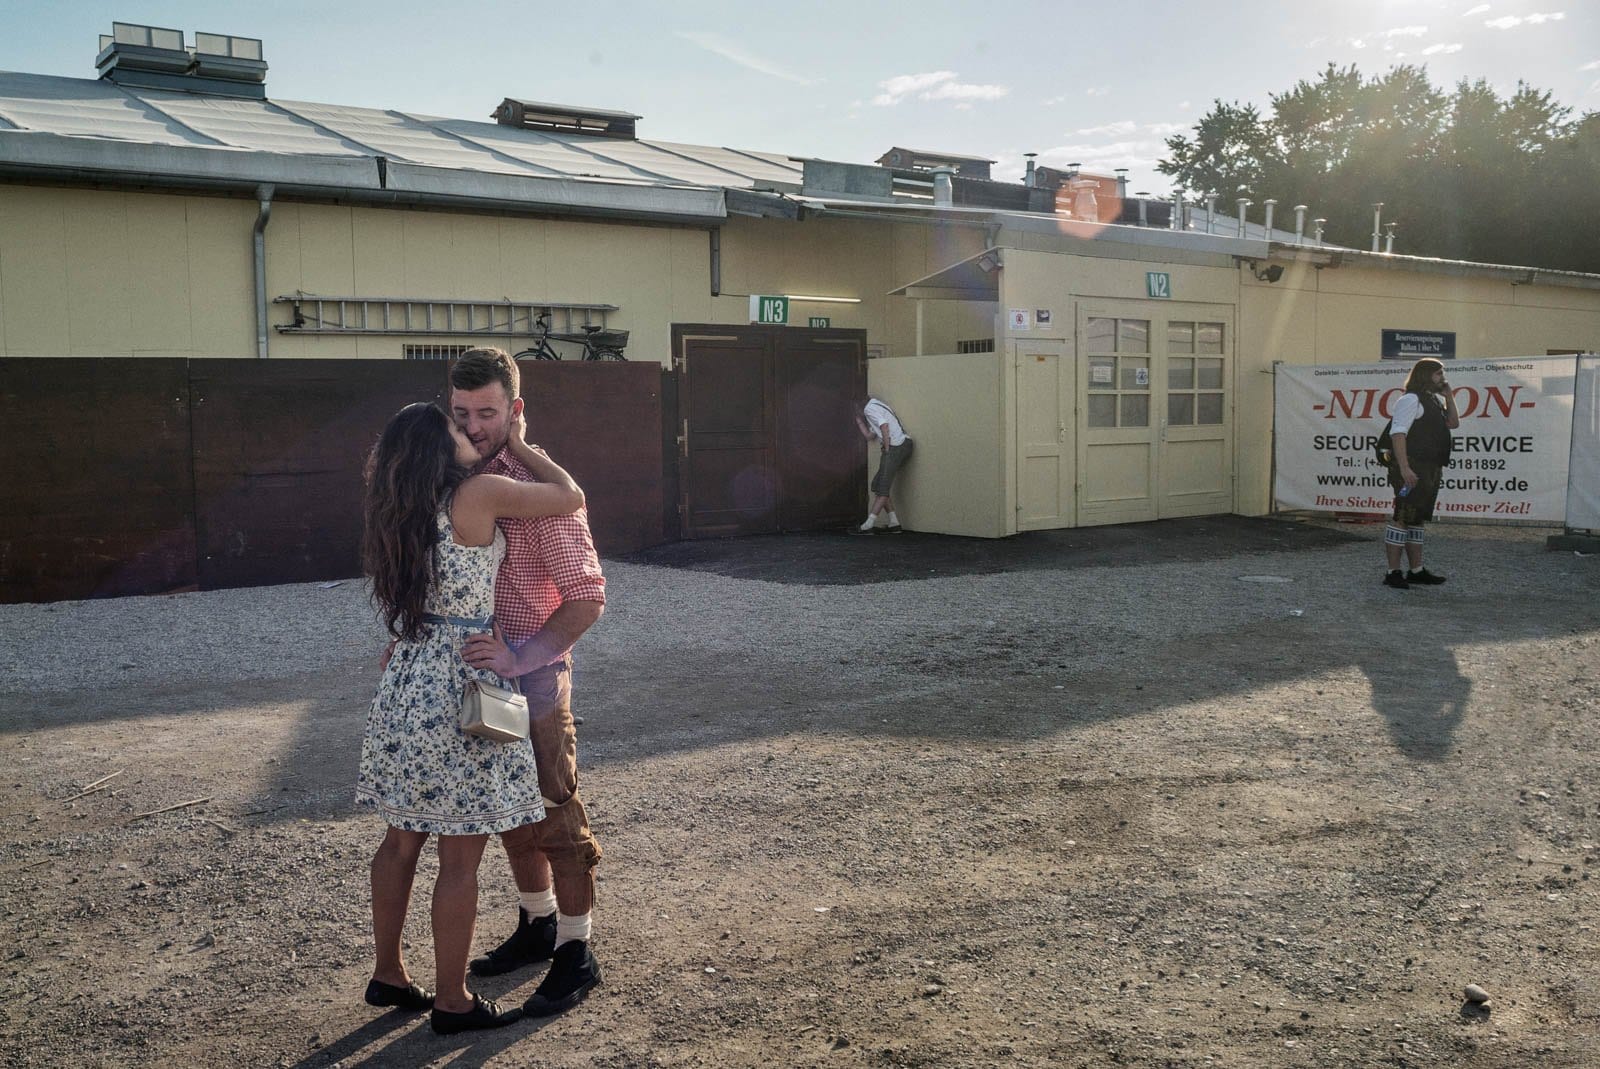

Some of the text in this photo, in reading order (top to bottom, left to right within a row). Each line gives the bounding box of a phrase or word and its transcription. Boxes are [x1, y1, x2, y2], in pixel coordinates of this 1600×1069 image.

[1150, 273, 1167, 297] N2
[763, 299, 784, 323] N3
[1346, 368, 1412, 376] Veranstaltungsschut
[1485, 364, 1534, 372] Objektschutz
[1313, 386, 1535, 419] -NICON-
[1313, 435, 1534, 453] SECUR ERVICE
[1336, 456, 1361, 467] Tel.:
[1315, 495, 1344, 506] Ihre
[1445, 503, 1490, 513] unser
[1494, 501, 1531, 514] Ziel!
